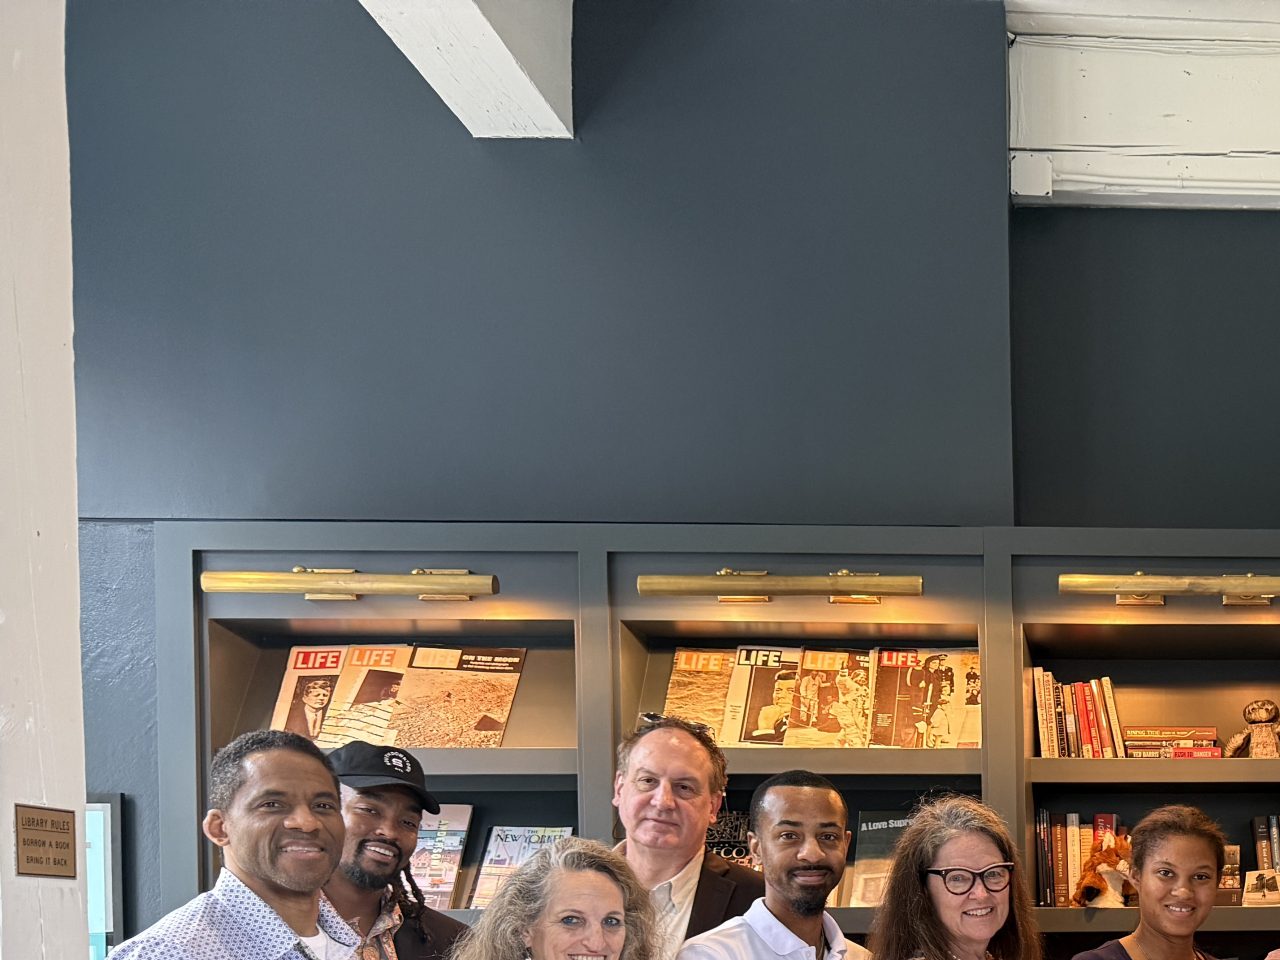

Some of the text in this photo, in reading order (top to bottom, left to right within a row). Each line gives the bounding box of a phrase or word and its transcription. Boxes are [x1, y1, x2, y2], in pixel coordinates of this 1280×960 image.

[295, 651, 340, 668] LIFE
[351, 649, 395, 666] LIFE
[680, 653, 720, 670] LIFE
[739, 650, 781, 667] LIFE
[883, 651, 917, 666] LIFE
[21, 816, 70, 831] LIBRARY RULES
[861, 822, 868, 831] A
[868, 821, 887, 830] Love
[22, 838, 70, 849] BORROW A BOOK
[496, 833, 521, 843] NEW
[26, 855, 67, 866] BRING IT BACK
